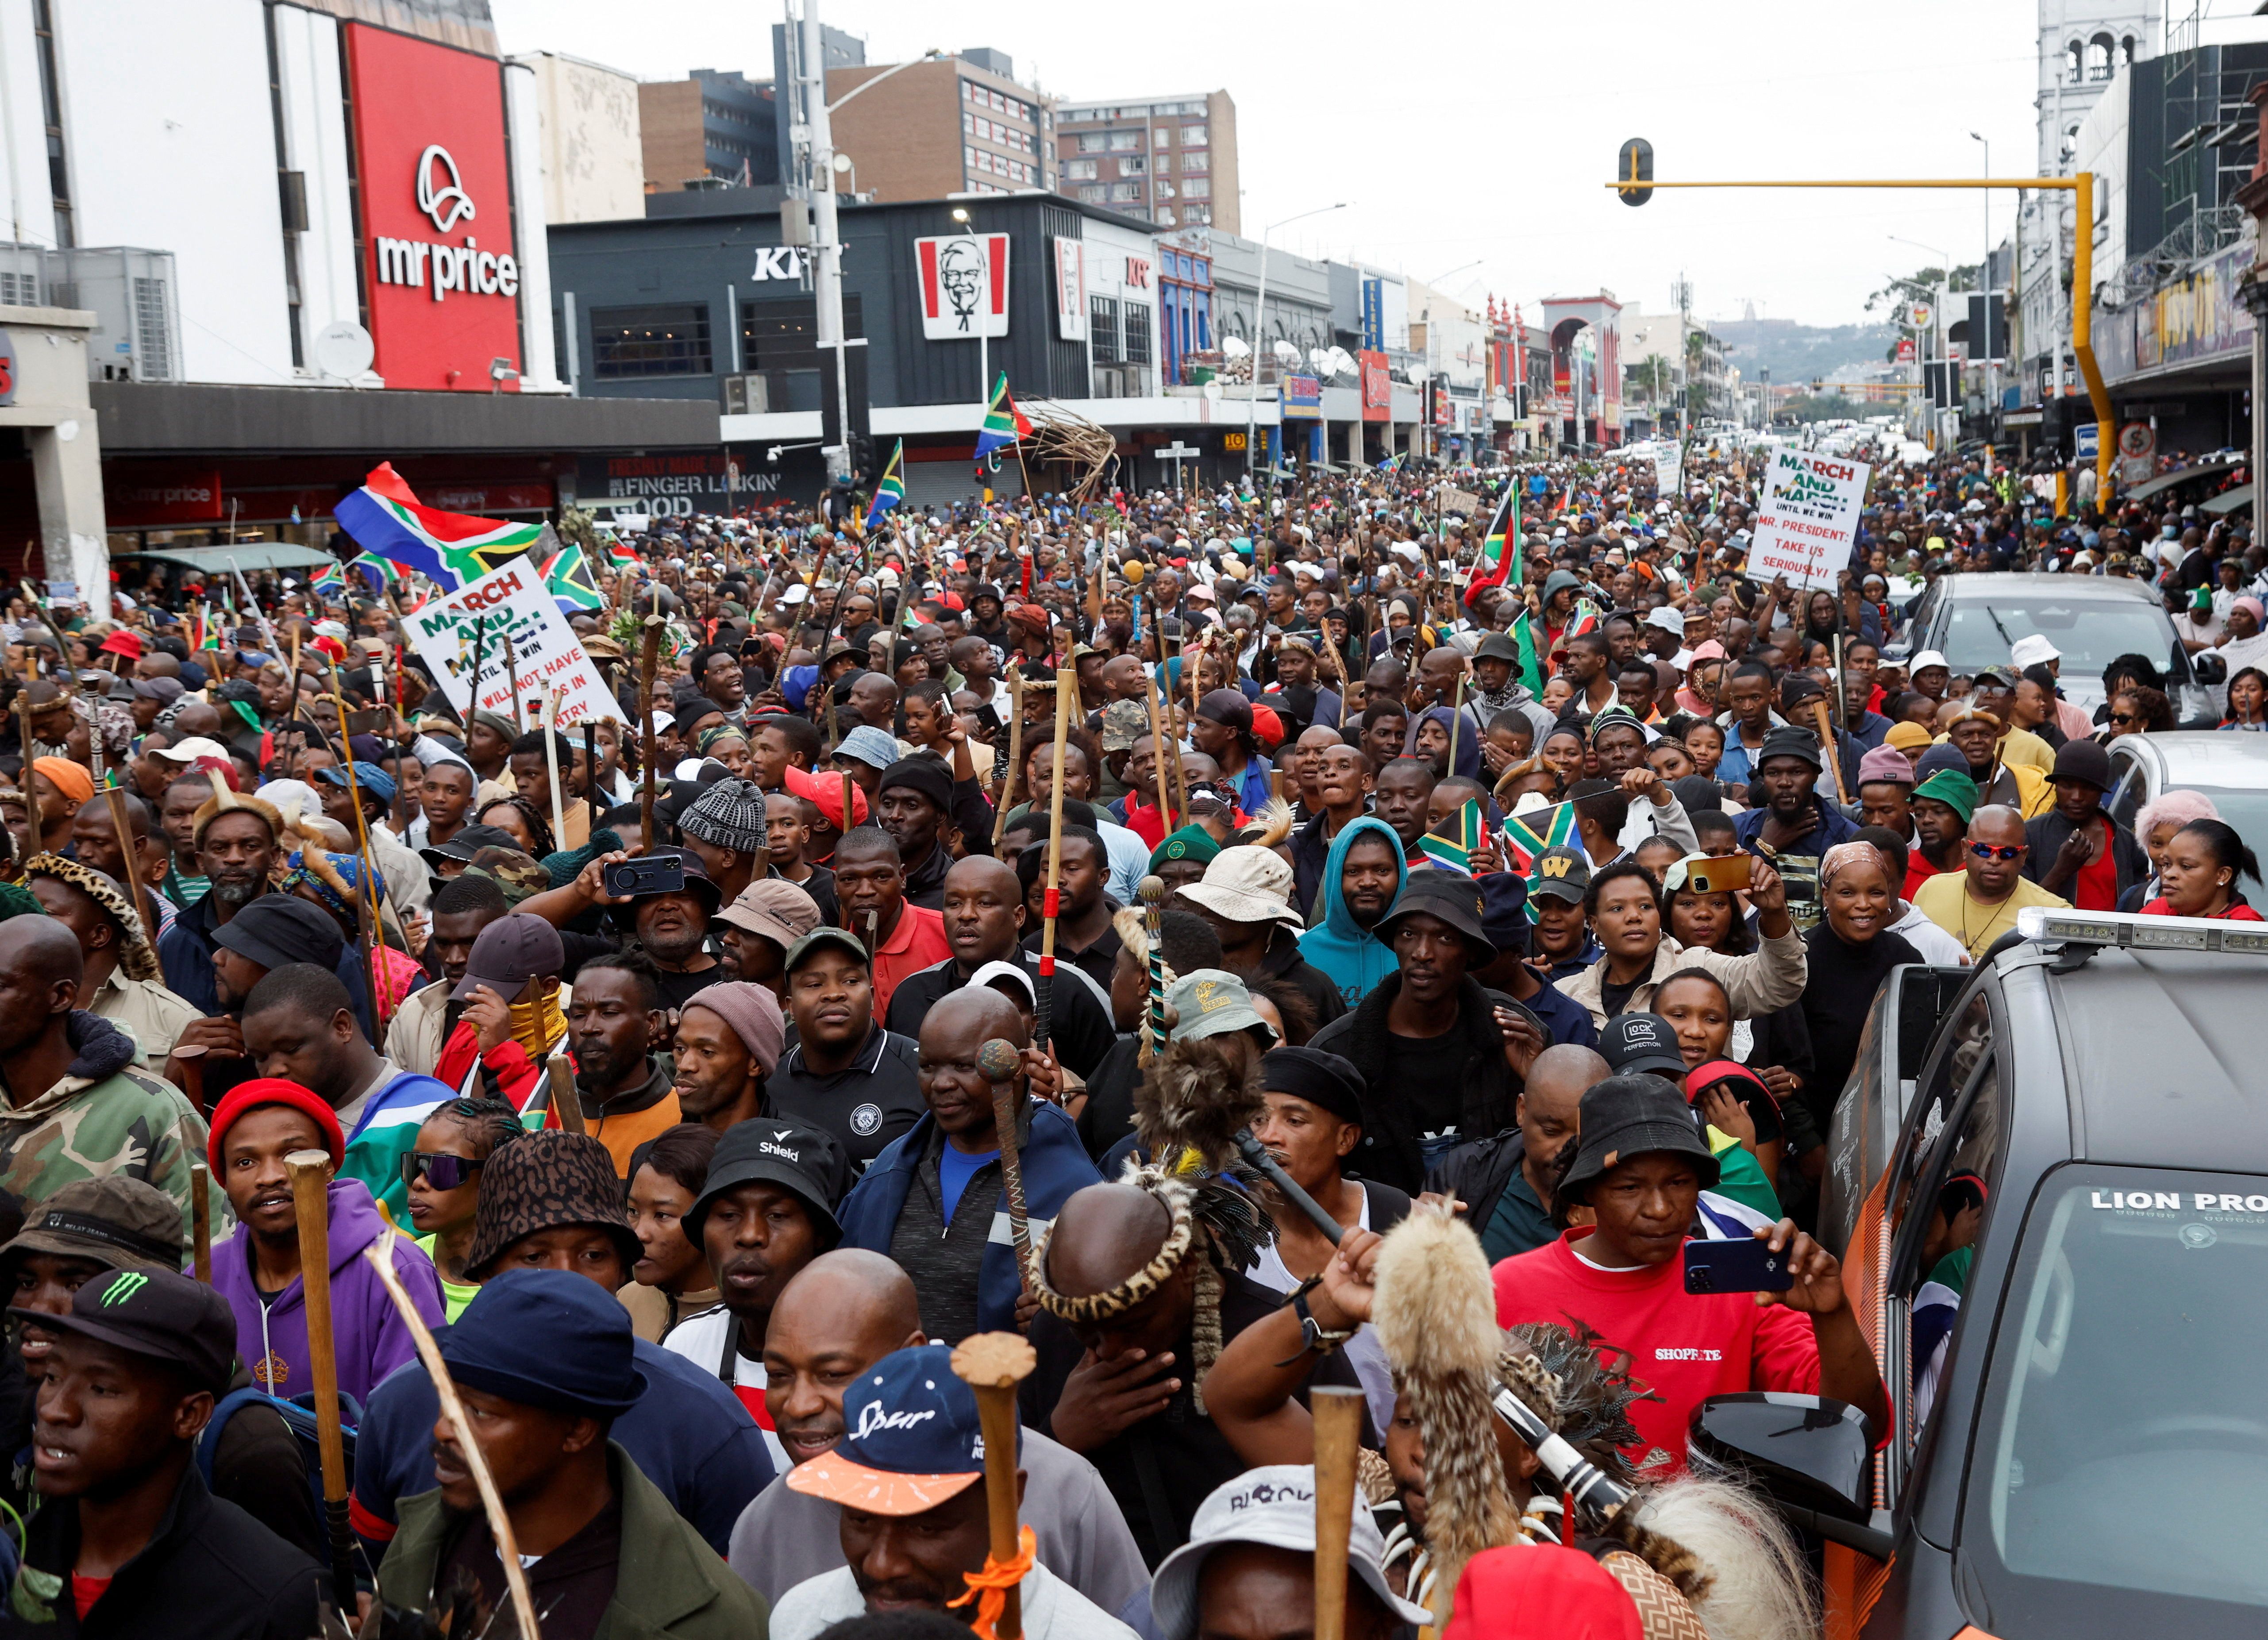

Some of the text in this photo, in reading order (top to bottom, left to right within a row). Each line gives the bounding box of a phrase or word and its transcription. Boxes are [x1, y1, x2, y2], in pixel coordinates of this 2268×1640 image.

[377, 236, 518, 301] mr price
[1779, 453, 1855, 481] MARCH
[626, 473, 782, 495] FINGER LKIN'
[1790, 473, 1836, 493] AND
[1773, 484, 1848, 512] MARCH
[1776, 502, 1833, 521] UNTIL WE WIN
[1758, 515, 1849, 543] MR. PRESIDENT:
[1775, 538, 1825, 558] TAKE US
[1762, 555, 1829, 578] SERIOUSLY!
[420, 571, 523, 638] MARCH
[458, 604, 514, 649] AND
[467, 665, 500, 688] UNTIL
[520, 641, 543, 659] WIN
[482, 687, 513, 709] WILL
[516, 669, 541, 692] NOT
[544, 647, 582, 676] HAVE
[571, 674, 587, 689] IN
[1541, 856, 1572, 878] W
[1624, 1042, 1661, 1052] PERFECTION
[855, 1108, 877, 1117] MANCHESTER
[759, 1142, 799, 1163] Shield
[2091, 1192, 2180, 1209] LION
[65, 1223, 108, 1238] RELAY JEANS
[848, 1399, 936, 1441] Spur
